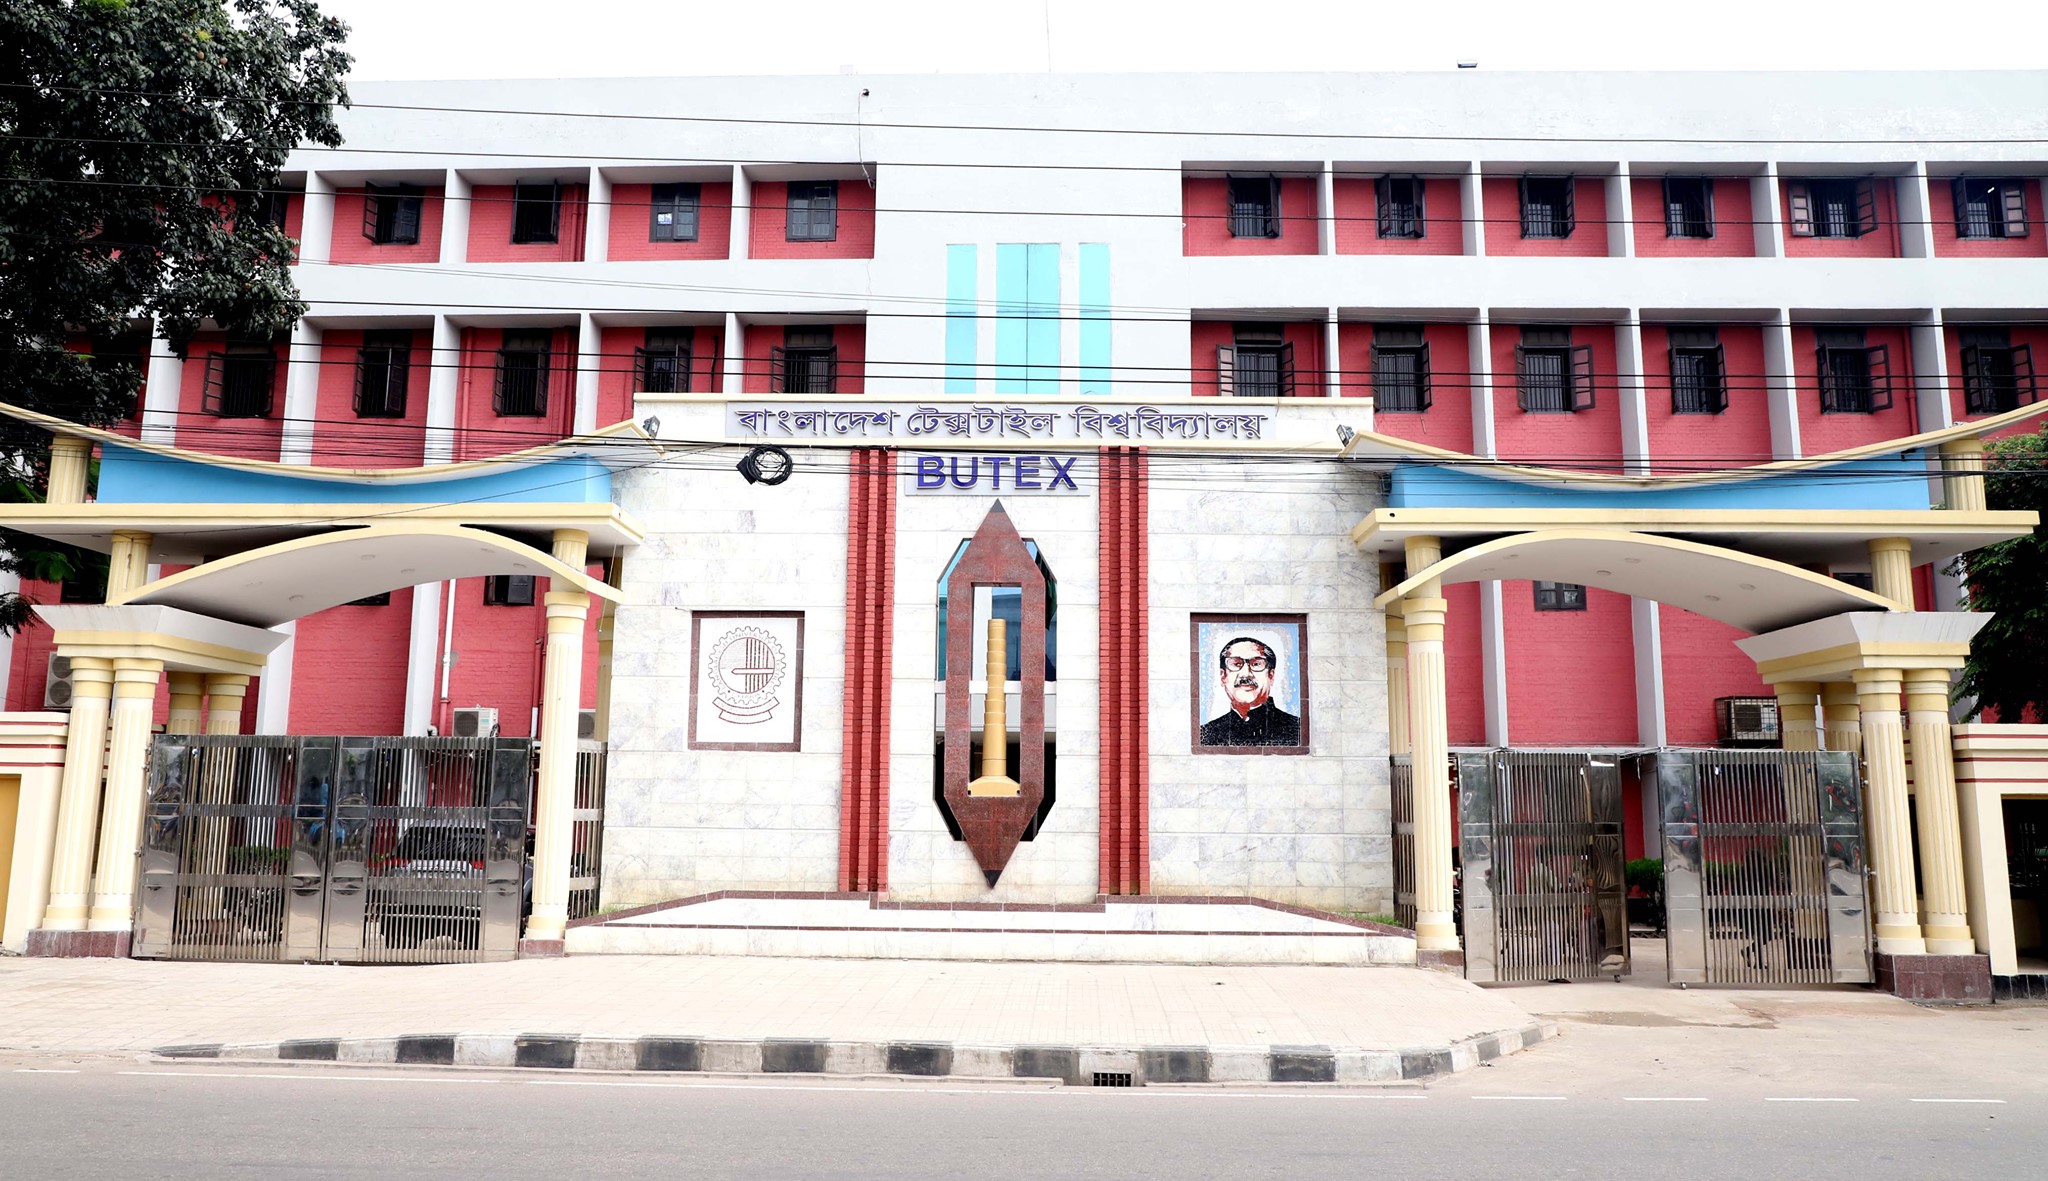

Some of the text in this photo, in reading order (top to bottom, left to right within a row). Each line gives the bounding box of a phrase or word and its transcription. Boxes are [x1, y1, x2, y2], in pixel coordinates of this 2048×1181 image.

[735, 404, 1268, 438] বাংলাদেশ টেক্সটাইল বিশ্ববিদ্যালয়
[916, 455, 1078, 490] BUTEX
